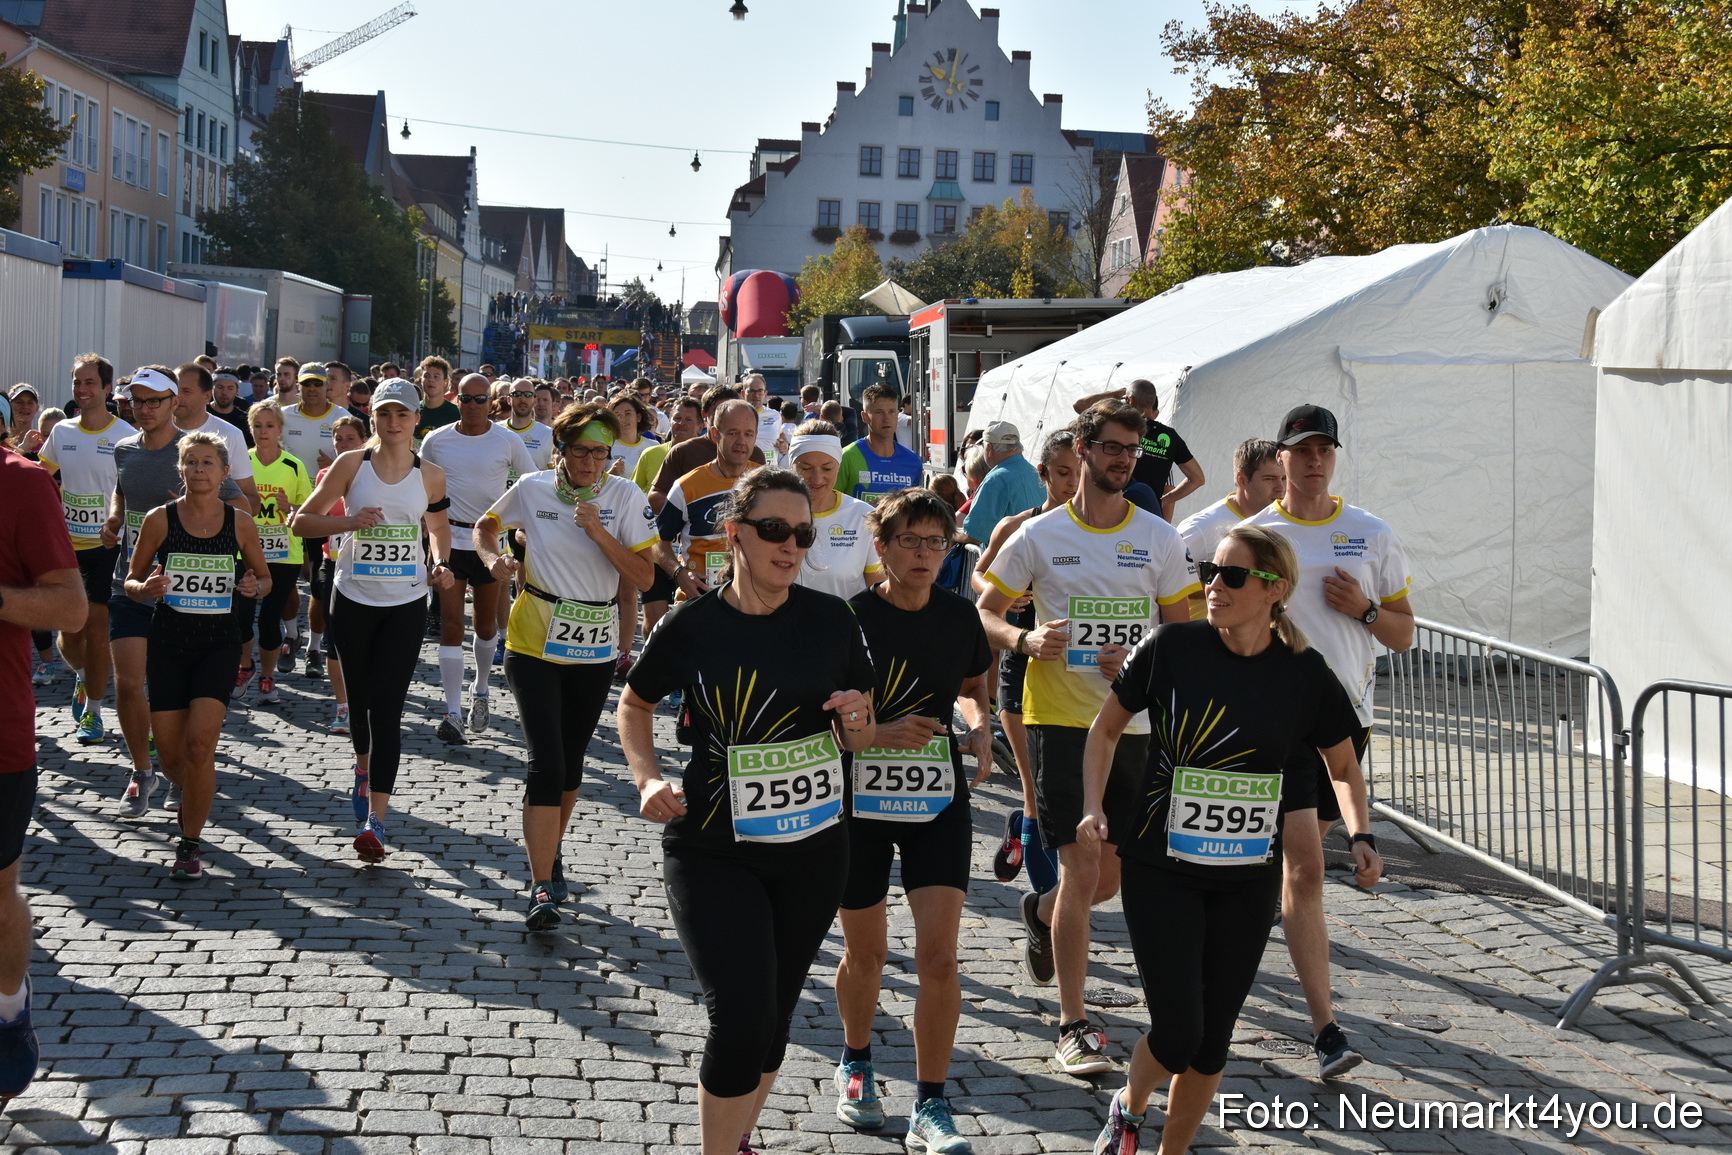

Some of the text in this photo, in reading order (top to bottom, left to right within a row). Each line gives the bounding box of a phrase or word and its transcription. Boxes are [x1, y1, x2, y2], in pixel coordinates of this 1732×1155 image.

[565, 330, 604, 341] START
[872, 471, 912, 486] Freitag
[257, 484, 283, 492] üller
[65, 491, 99, 506] BOCK
[65, 506, 98, 523] 2201
[258, 526, 284, 535] OCK
[358, 525, 414, 539] BOCK
[831, 527, 843, 535] 20
[1332, 534, 1348, 544] 20
[360, 543, 411, 562] 2332
[1117, 543, 1133, 554] 20
[170, 555, 230, 571] BOCK
[369, 566, 402, 575] KLAUS
[172, 574, 227, 594] 2645
[179, 597, 218, 608] GISELA
[1074, 599, 1146, 617] BOCK
[558, 602, 613, 622] BOCK
[556, 622, 610, 644] 2415
[1077, 623, 1143, 647] 2358
[566, 648, 596, 657] ROSA
[737, 737, 832, 774] BOCK
[865, 765, 943, 792] 2592
[1180, 771, 1274, 799] BOCK
[745, 769, 832, 812] 2593
[880, 799, 929, 812] MARIA
[776, 813, 811, 832] UTE
[1181, 802, 1267, 834] 2595
[1197, 841, 1244, 855] JULIA
